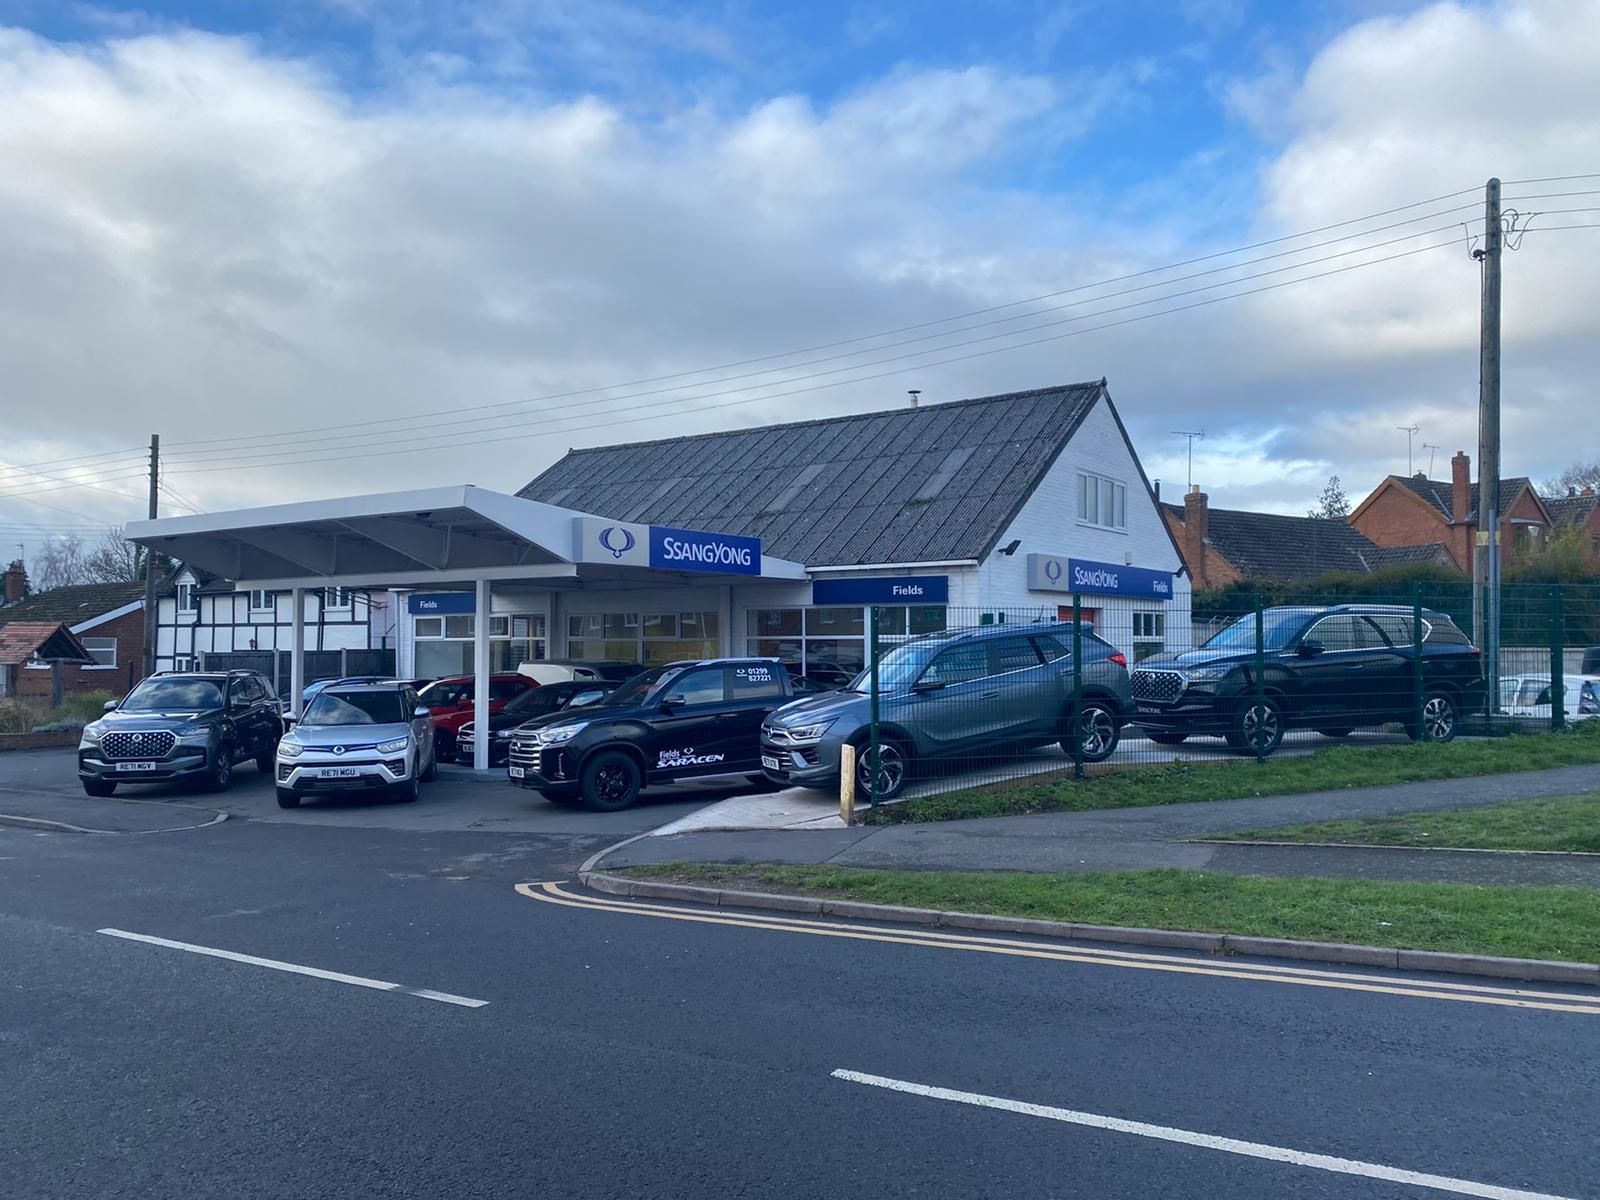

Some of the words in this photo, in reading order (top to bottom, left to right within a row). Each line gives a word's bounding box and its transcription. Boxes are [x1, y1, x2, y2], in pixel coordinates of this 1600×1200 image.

[893, 585, 923, 595] Fields
[1153, 580, 1168, 593] Fields
[420, 600, 438, 609] Fields
[659, 750, 680, 759] Fields
[656, 753, 725, 768] SARACEN
[321, 769, 338, 777] RE71
[339, 768, 356, 776] MGU
